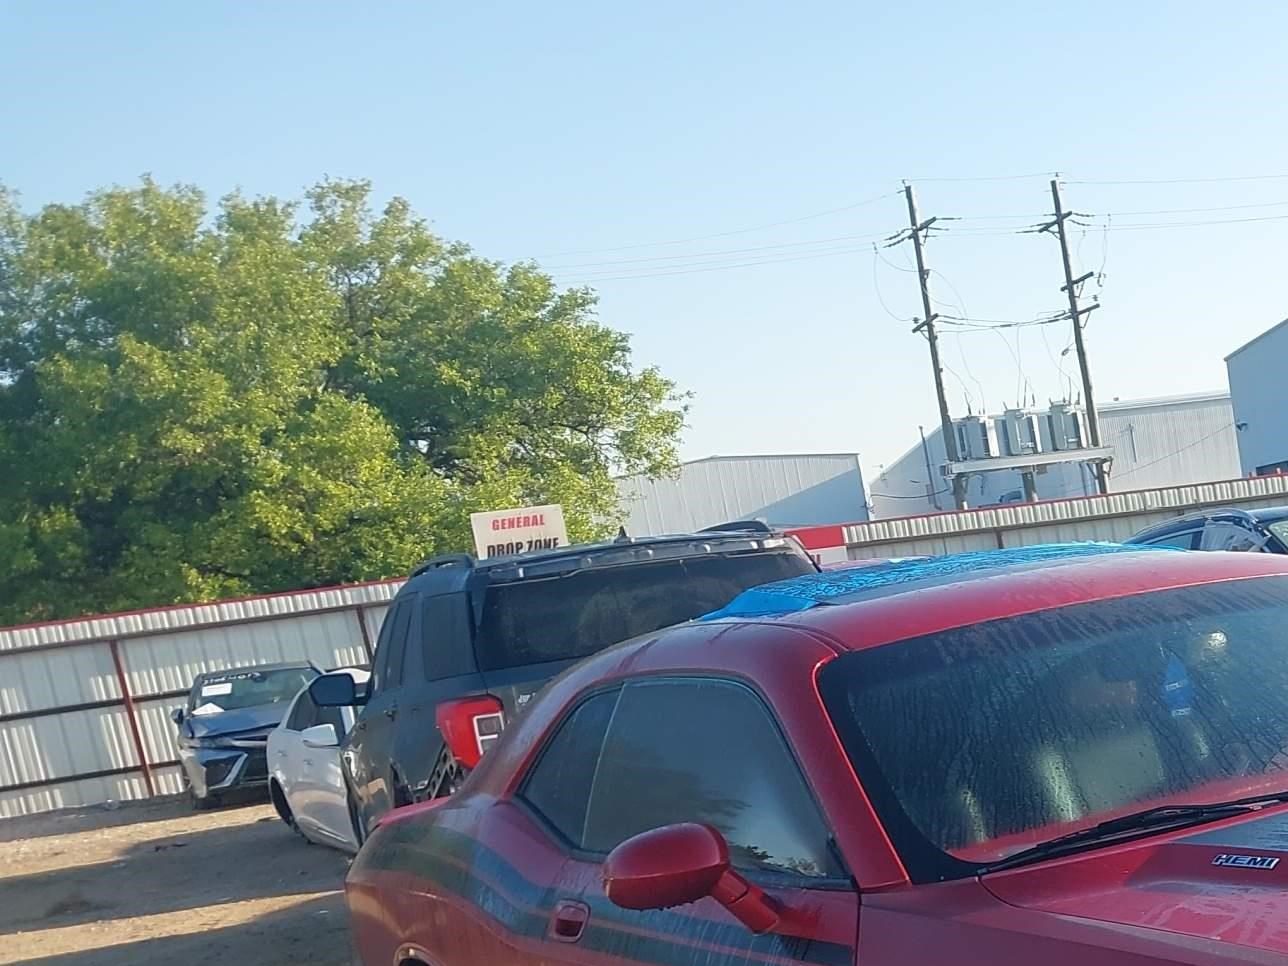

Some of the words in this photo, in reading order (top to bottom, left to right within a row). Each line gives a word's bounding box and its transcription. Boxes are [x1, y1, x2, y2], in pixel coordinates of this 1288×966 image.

[491, 514, 545, 531] GENERAL
[486, 541, 524, 558] DROP
[1211, 854, 1280, 869] HEMI
